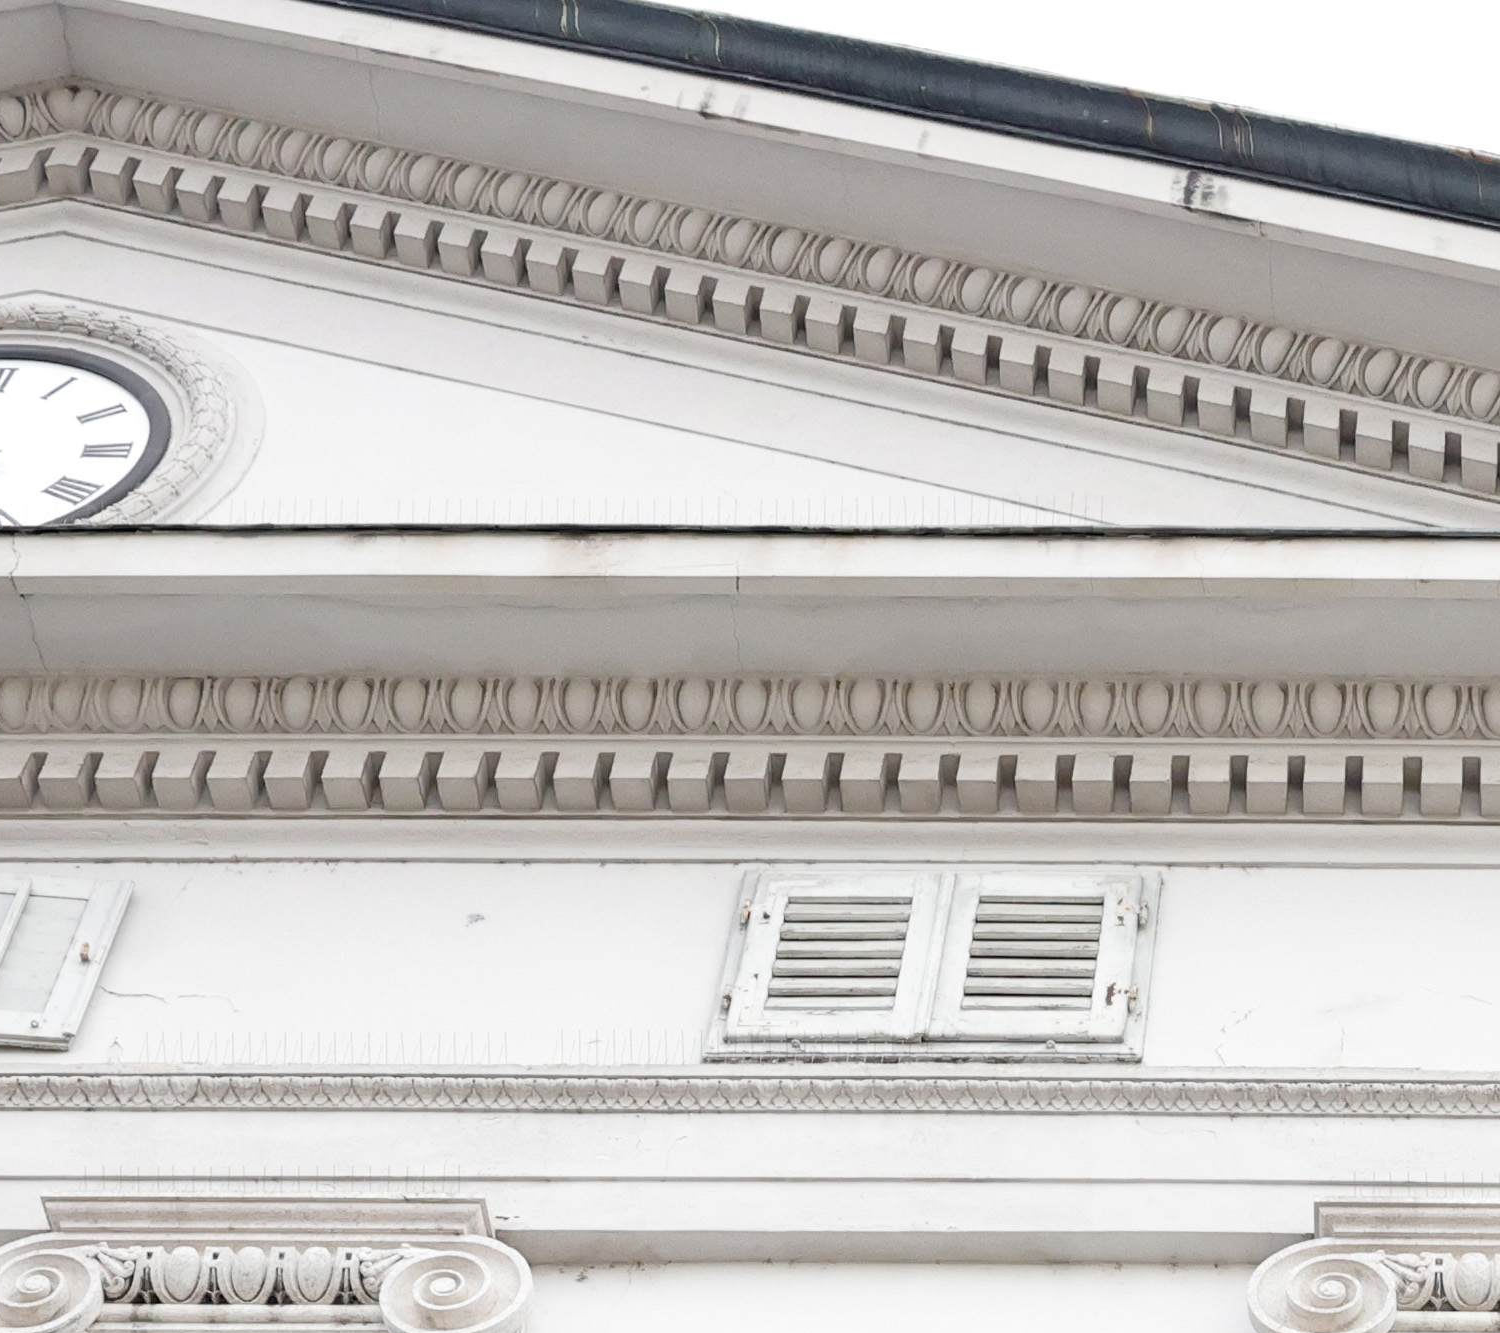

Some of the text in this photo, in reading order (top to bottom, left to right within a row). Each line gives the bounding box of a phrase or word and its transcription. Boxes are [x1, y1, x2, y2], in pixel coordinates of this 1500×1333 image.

[40, 376, 78, 400] I
[76, 403, 128, 424] II
[80, 441, 134, 459] III
[40, 475, 105, 506] IIII
